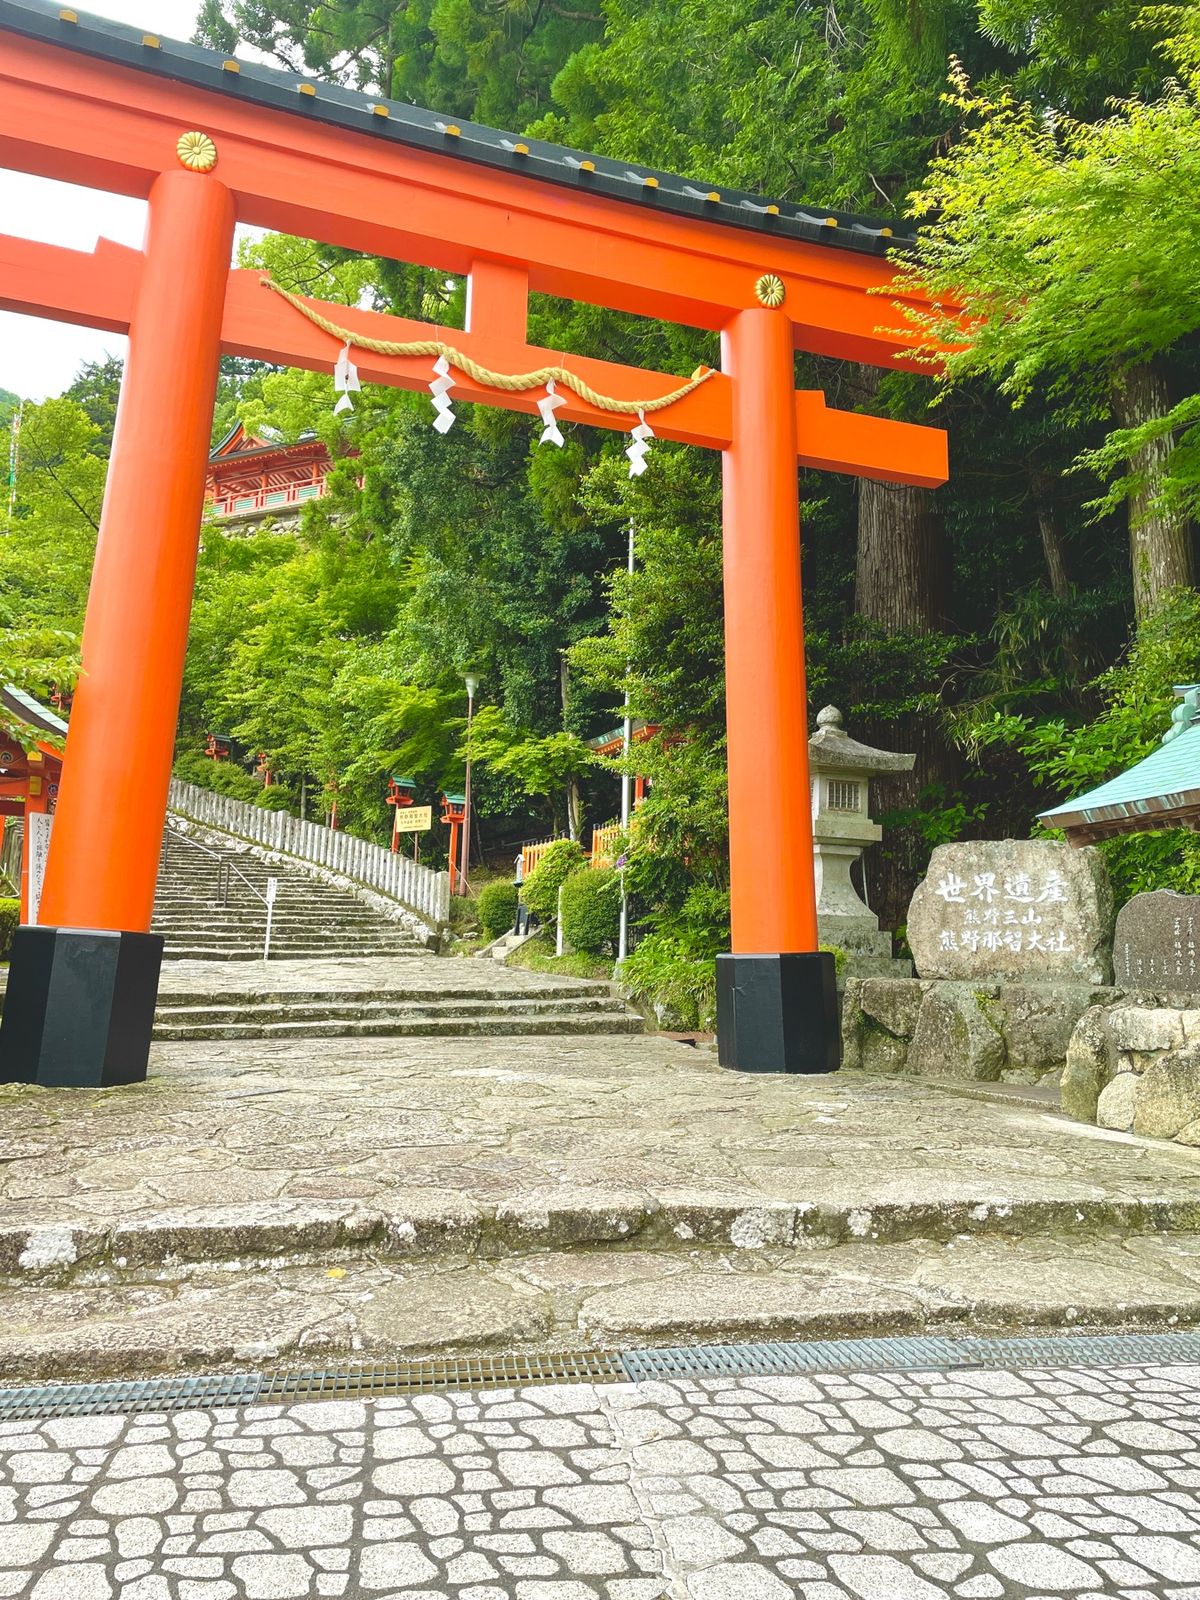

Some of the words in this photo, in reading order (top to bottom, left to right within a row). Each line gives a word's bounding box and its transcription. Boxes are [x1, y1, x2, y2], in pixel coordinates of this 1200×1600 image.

[935, 870, 1069, 903] 世界遺産
[963, 908, 1042, 925] 熊野三山
[938, 929, 1073, 952] 熊野那智大社
